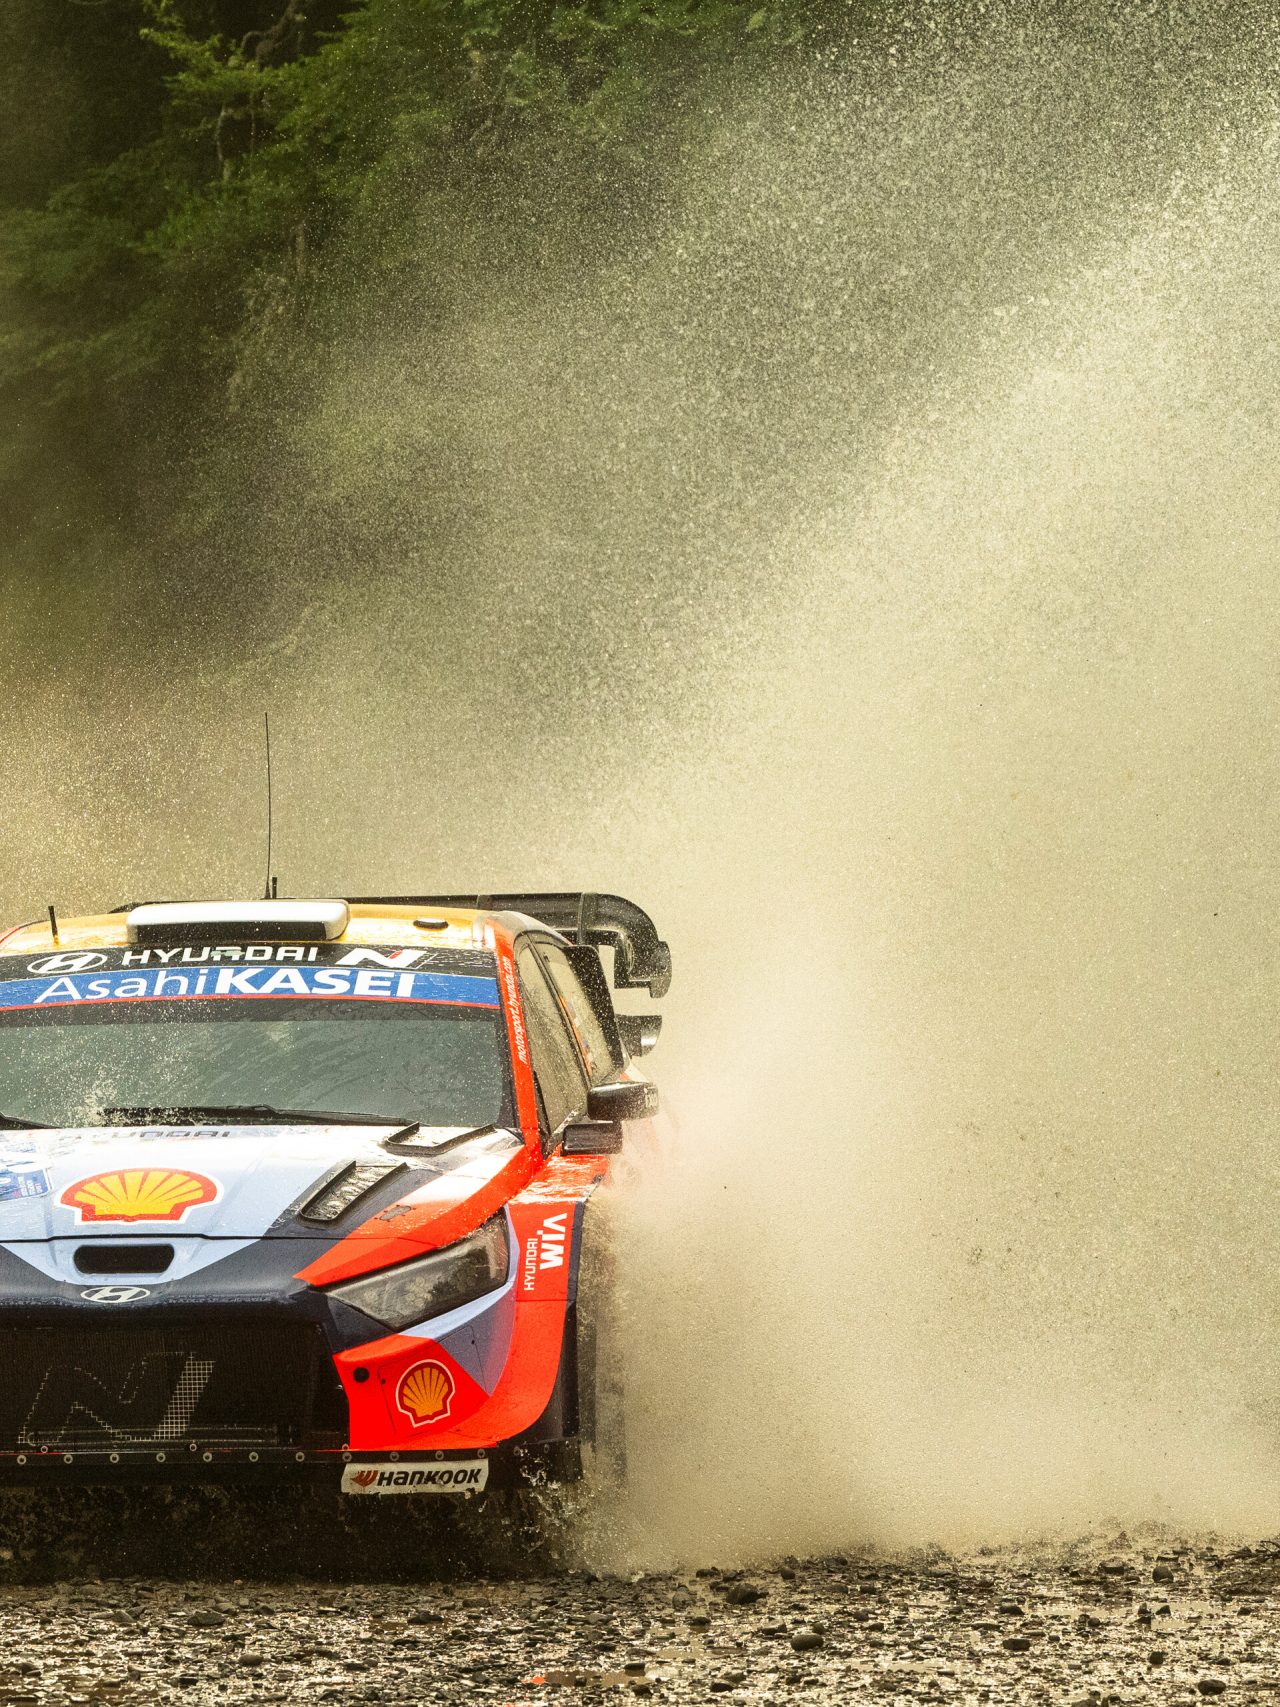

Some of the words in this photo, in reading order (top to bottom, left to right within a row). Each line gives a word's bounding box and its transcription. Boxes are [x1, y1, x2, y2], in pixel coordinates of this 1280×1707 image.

[121, 946, 319, 966] HYUNDAI
[503, 956, 528, 1064] motorsport.hyundai.com
[523, 1238, 539, 1291] HYUNDAI
